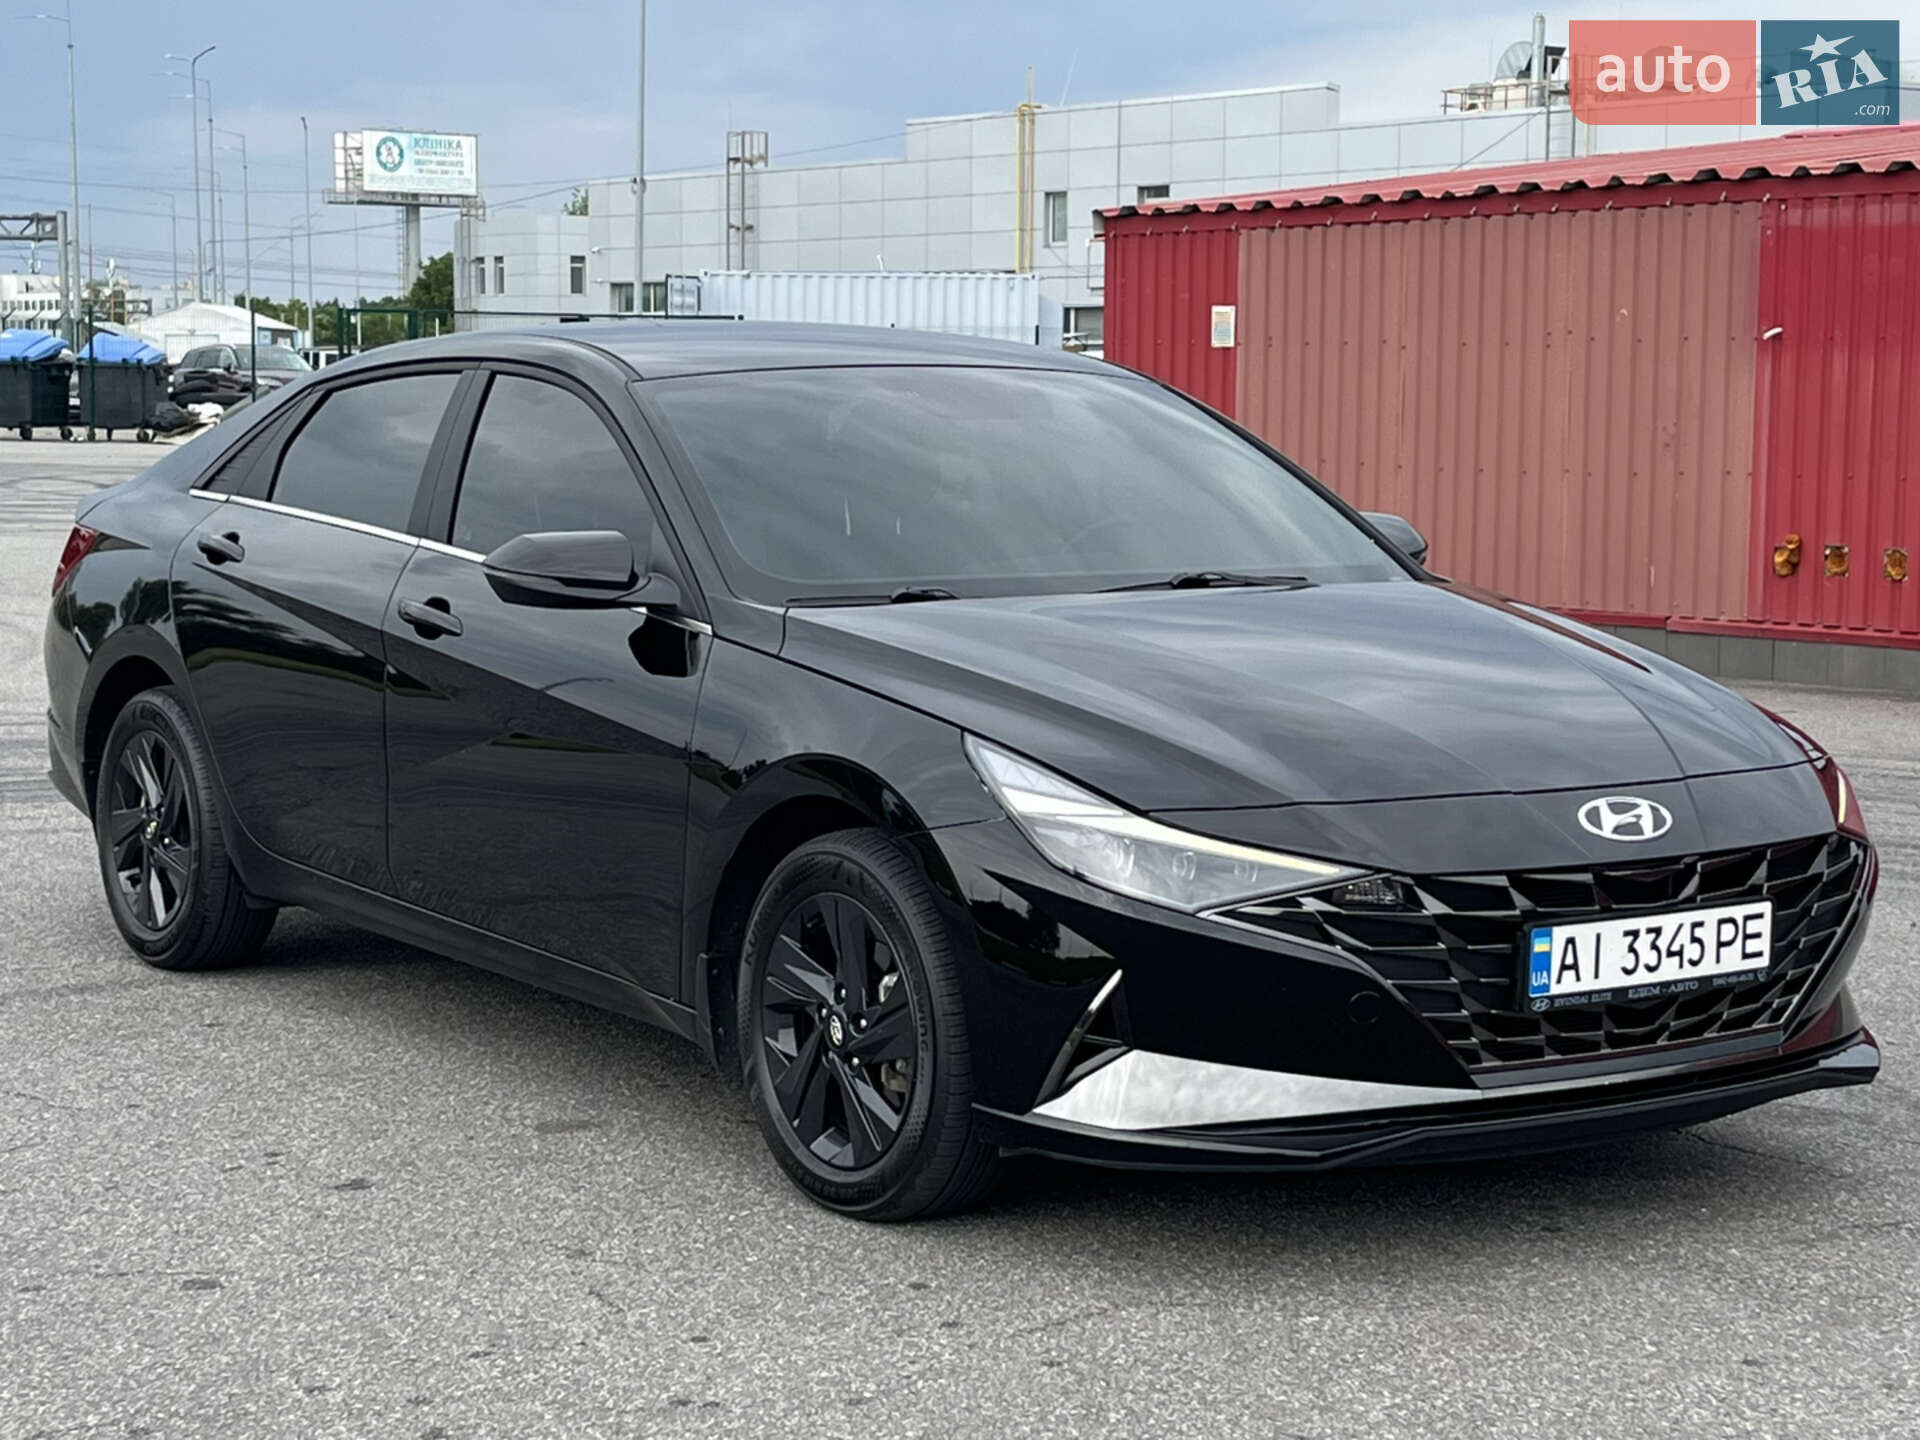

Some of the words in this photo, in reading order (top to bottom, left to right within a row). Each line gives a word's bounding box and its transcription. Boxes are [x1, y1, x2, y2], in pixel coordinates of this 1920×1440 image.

[414, 137, 463, 151] КЛІНІКА
[1556, 932, 1601, 984] AI
[1620, 921, 1705, 976] 3345
[1715, 912, 1765, 964] PE
[1532, 972, 1550, 986] UA
